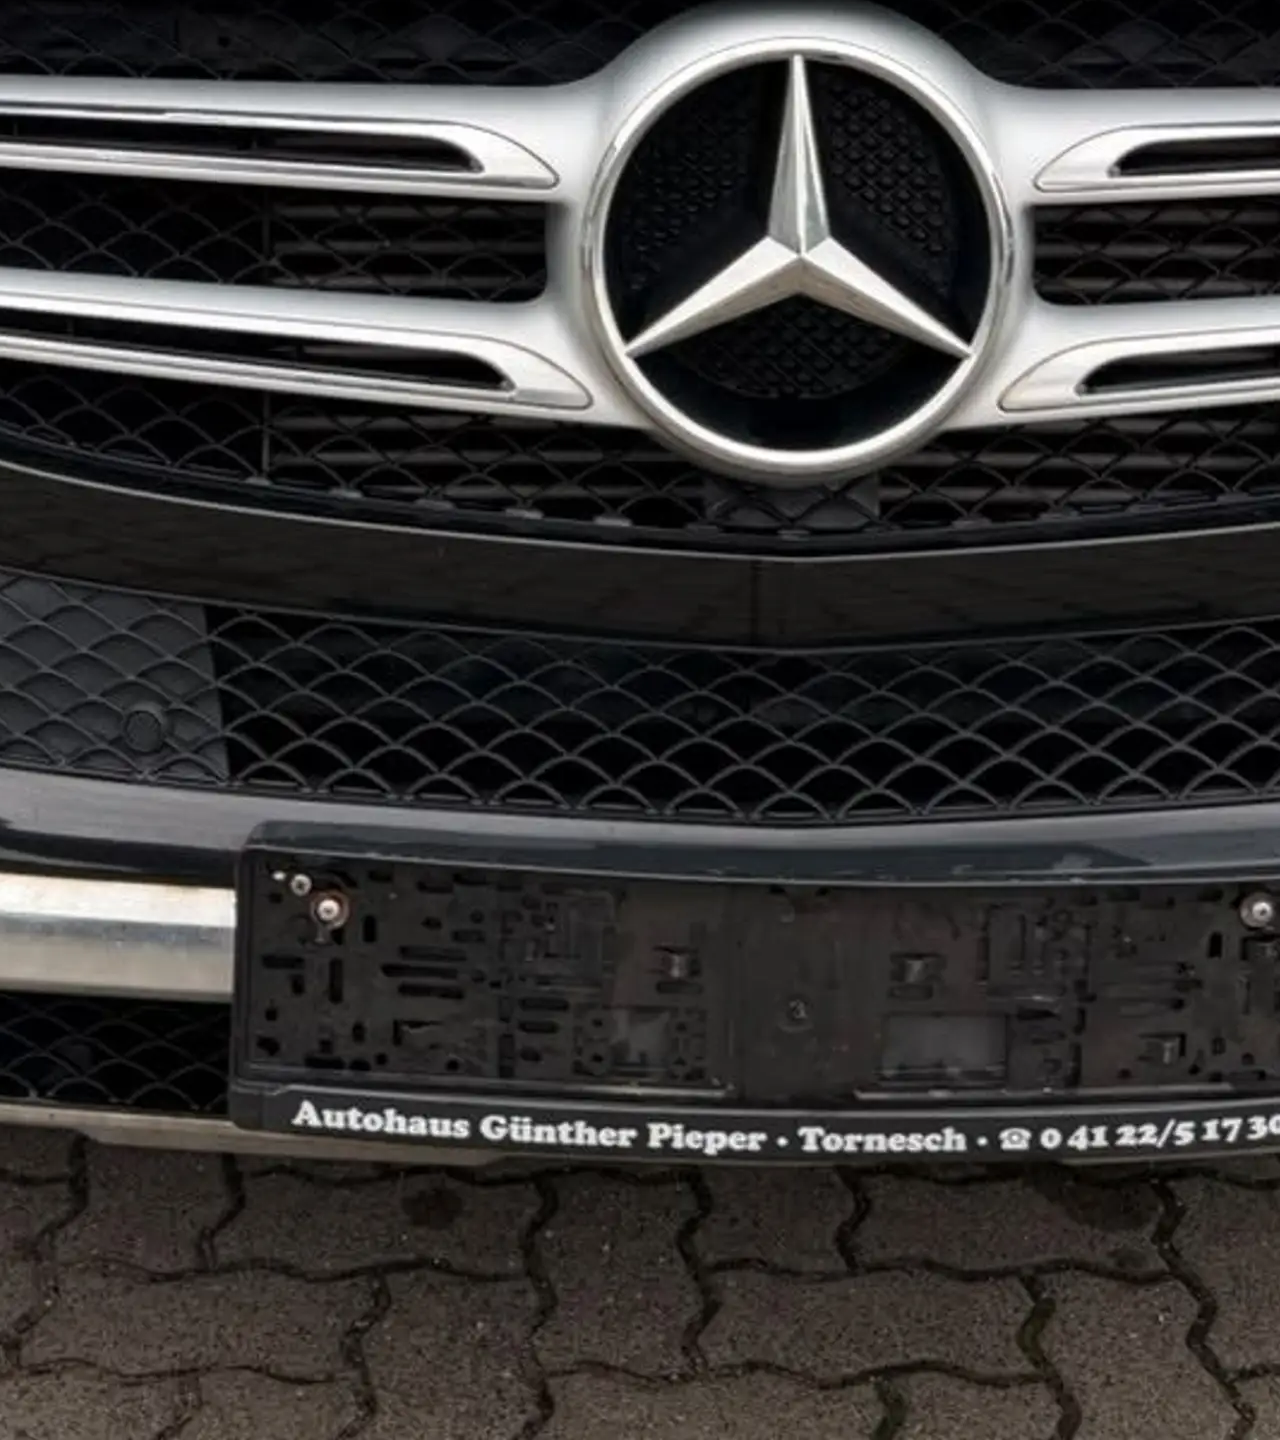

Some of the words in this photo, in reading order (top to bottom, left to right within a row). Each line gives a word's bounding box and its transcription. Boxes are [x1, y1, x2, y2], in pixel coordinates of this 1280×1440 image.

[292, 1100, 470, 1138] Autohaus
[480, 1115, 638, 1147] Günther
[647, 1122, 767, 1155] Pieper
[798, 1126, 968, 1152] Tornesch
[1040, 1128, 1062, 1149] 0
[1068, 1125, 1109, 1151] 41
